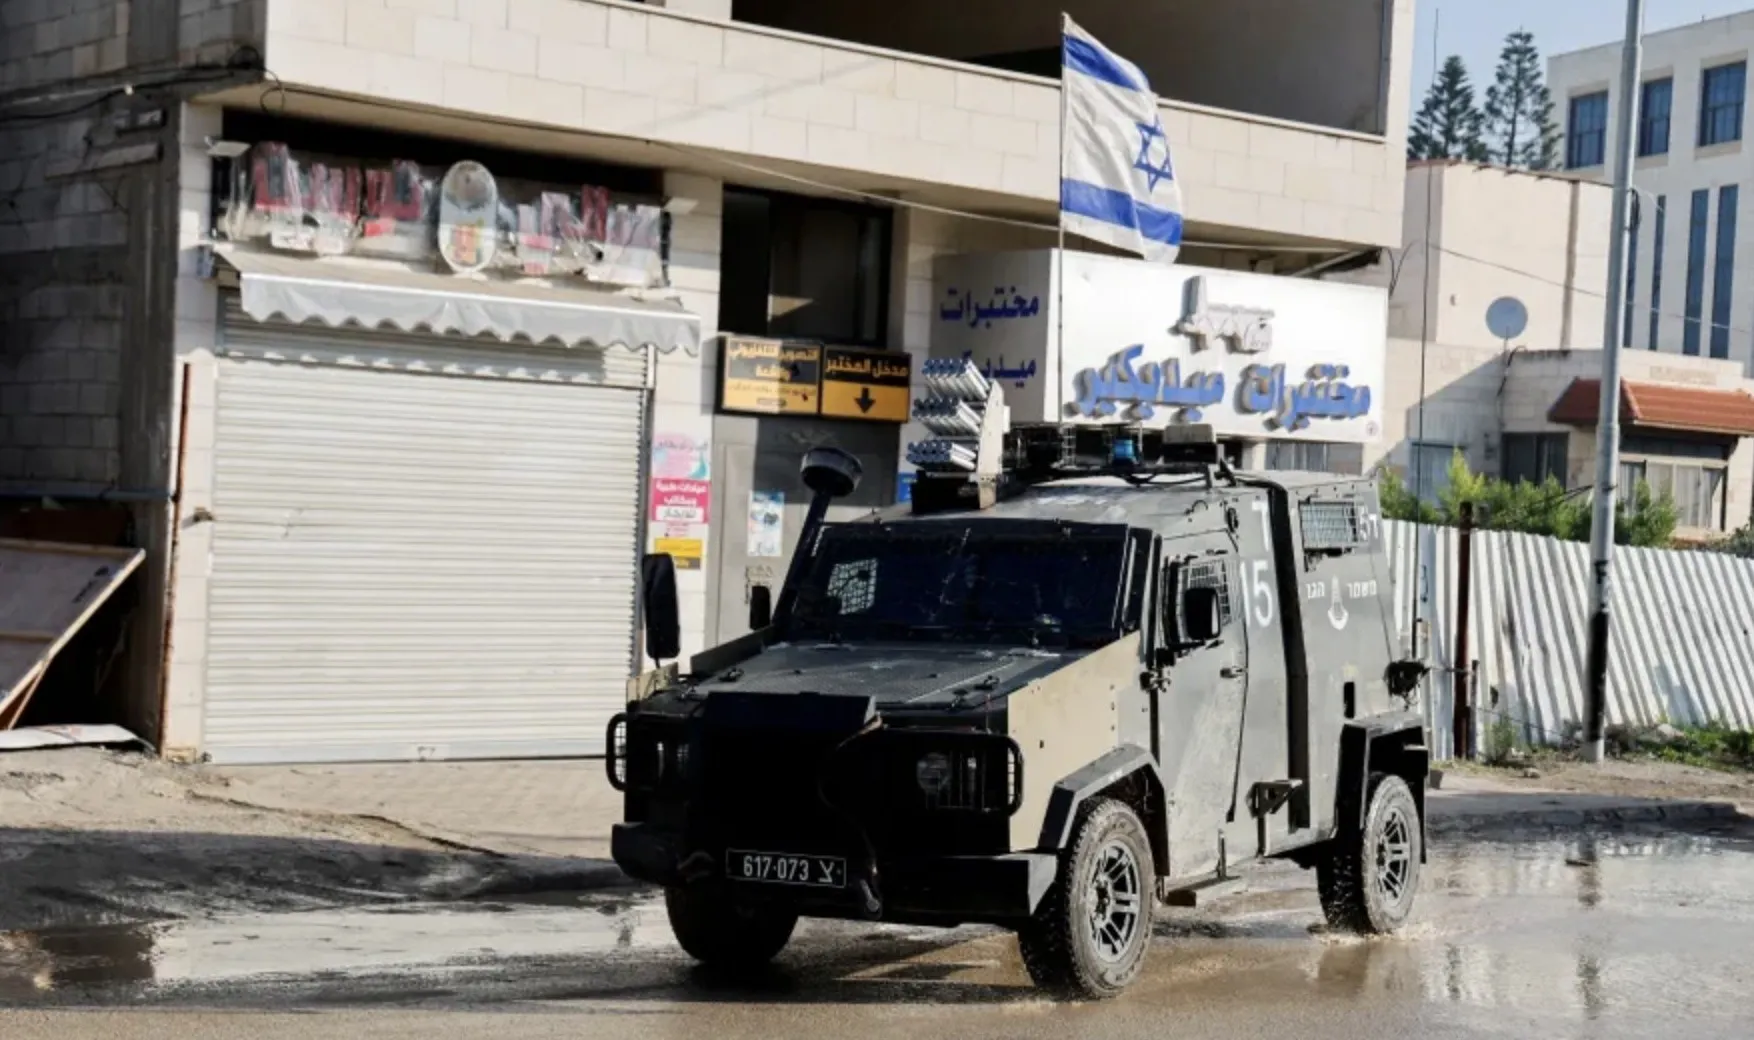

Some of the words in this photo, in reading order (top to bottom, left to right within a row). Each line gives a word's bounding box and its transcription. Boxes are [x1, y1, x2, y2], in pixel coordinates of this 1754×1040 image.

[940, 285, 1039, 329] مختبرات
[825, 355, 871, 376] المختبر
[872, 360, 909, 378] مدخل
[1238, 363, 1371, 432] مختبرات
